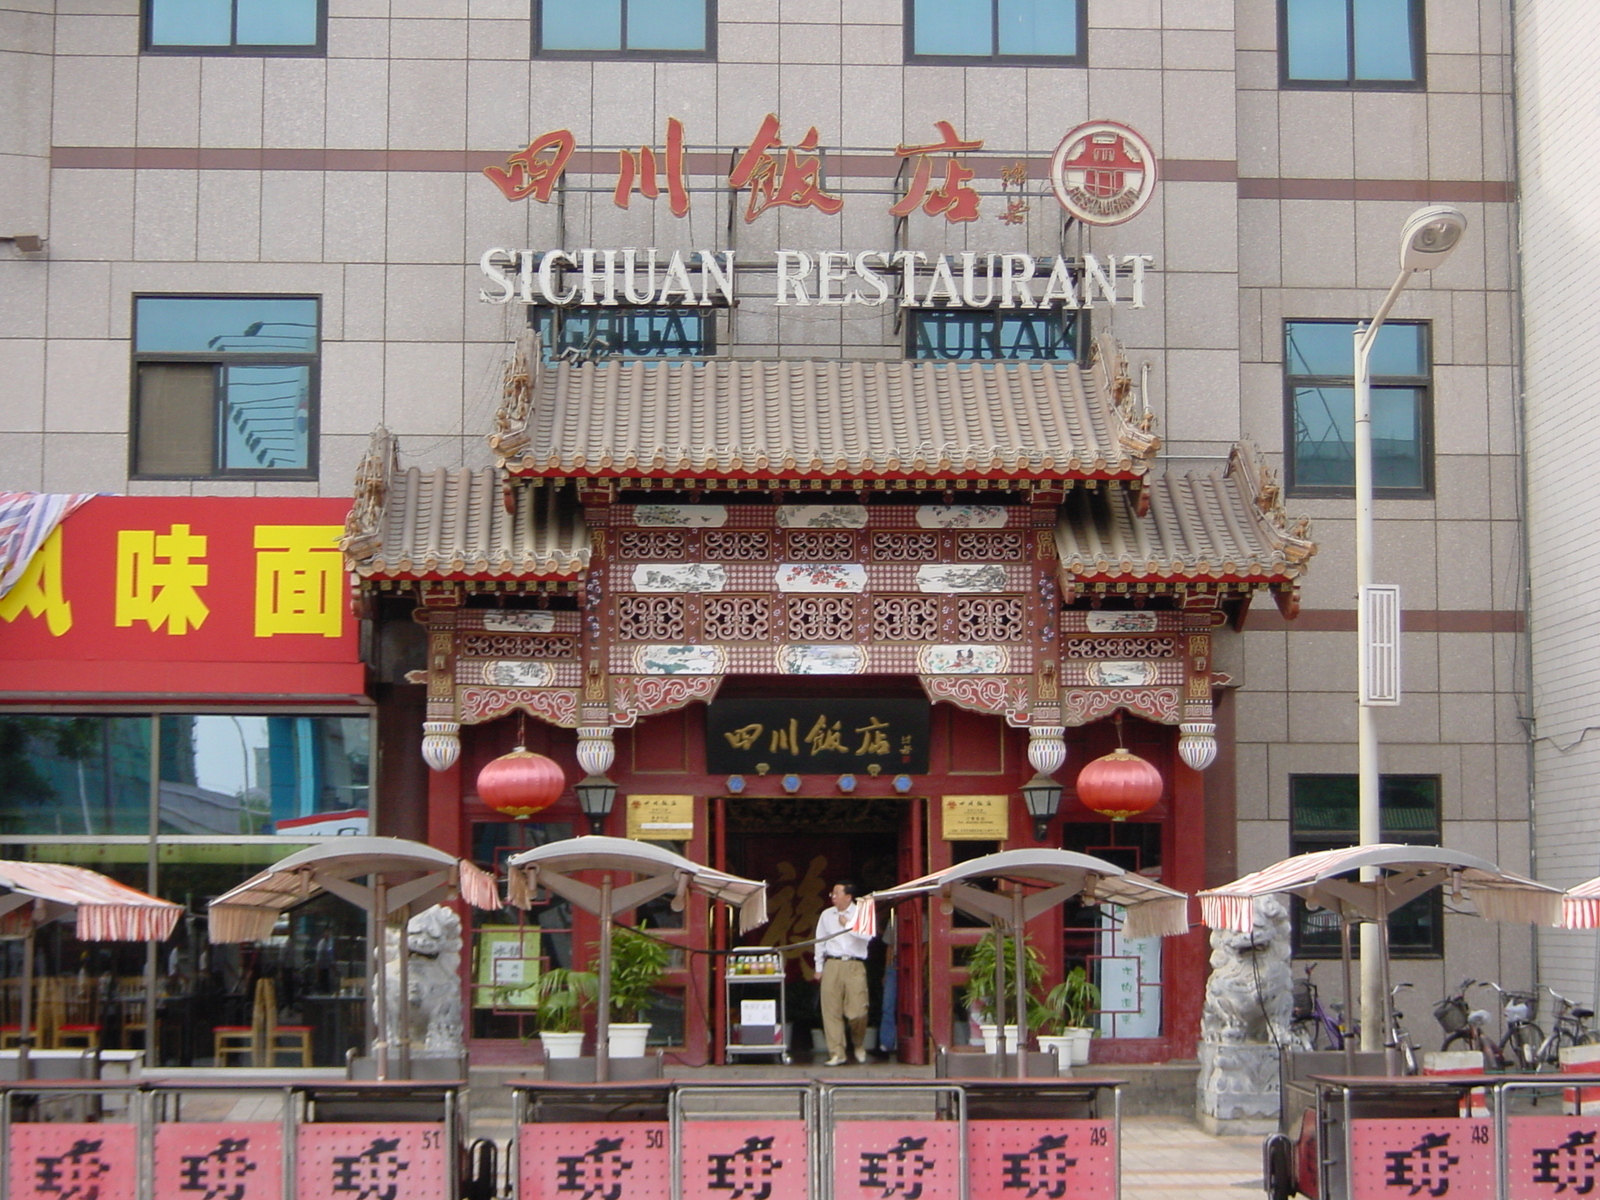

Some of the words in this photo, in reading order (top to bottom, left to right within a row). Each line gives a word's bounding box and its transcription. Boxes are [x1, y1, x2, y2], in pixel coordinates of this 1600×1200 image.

[478, 247, 736, 307] SICHUAN
[774, 249, 1154, 310] RESTAURANT
[422, 1130, 441, 1150] 51
[645, 1130, 663, 1150] 50
[1090, 1127, 1107, 1147] 49
[1472, 1125, 1489, 1144] 48
